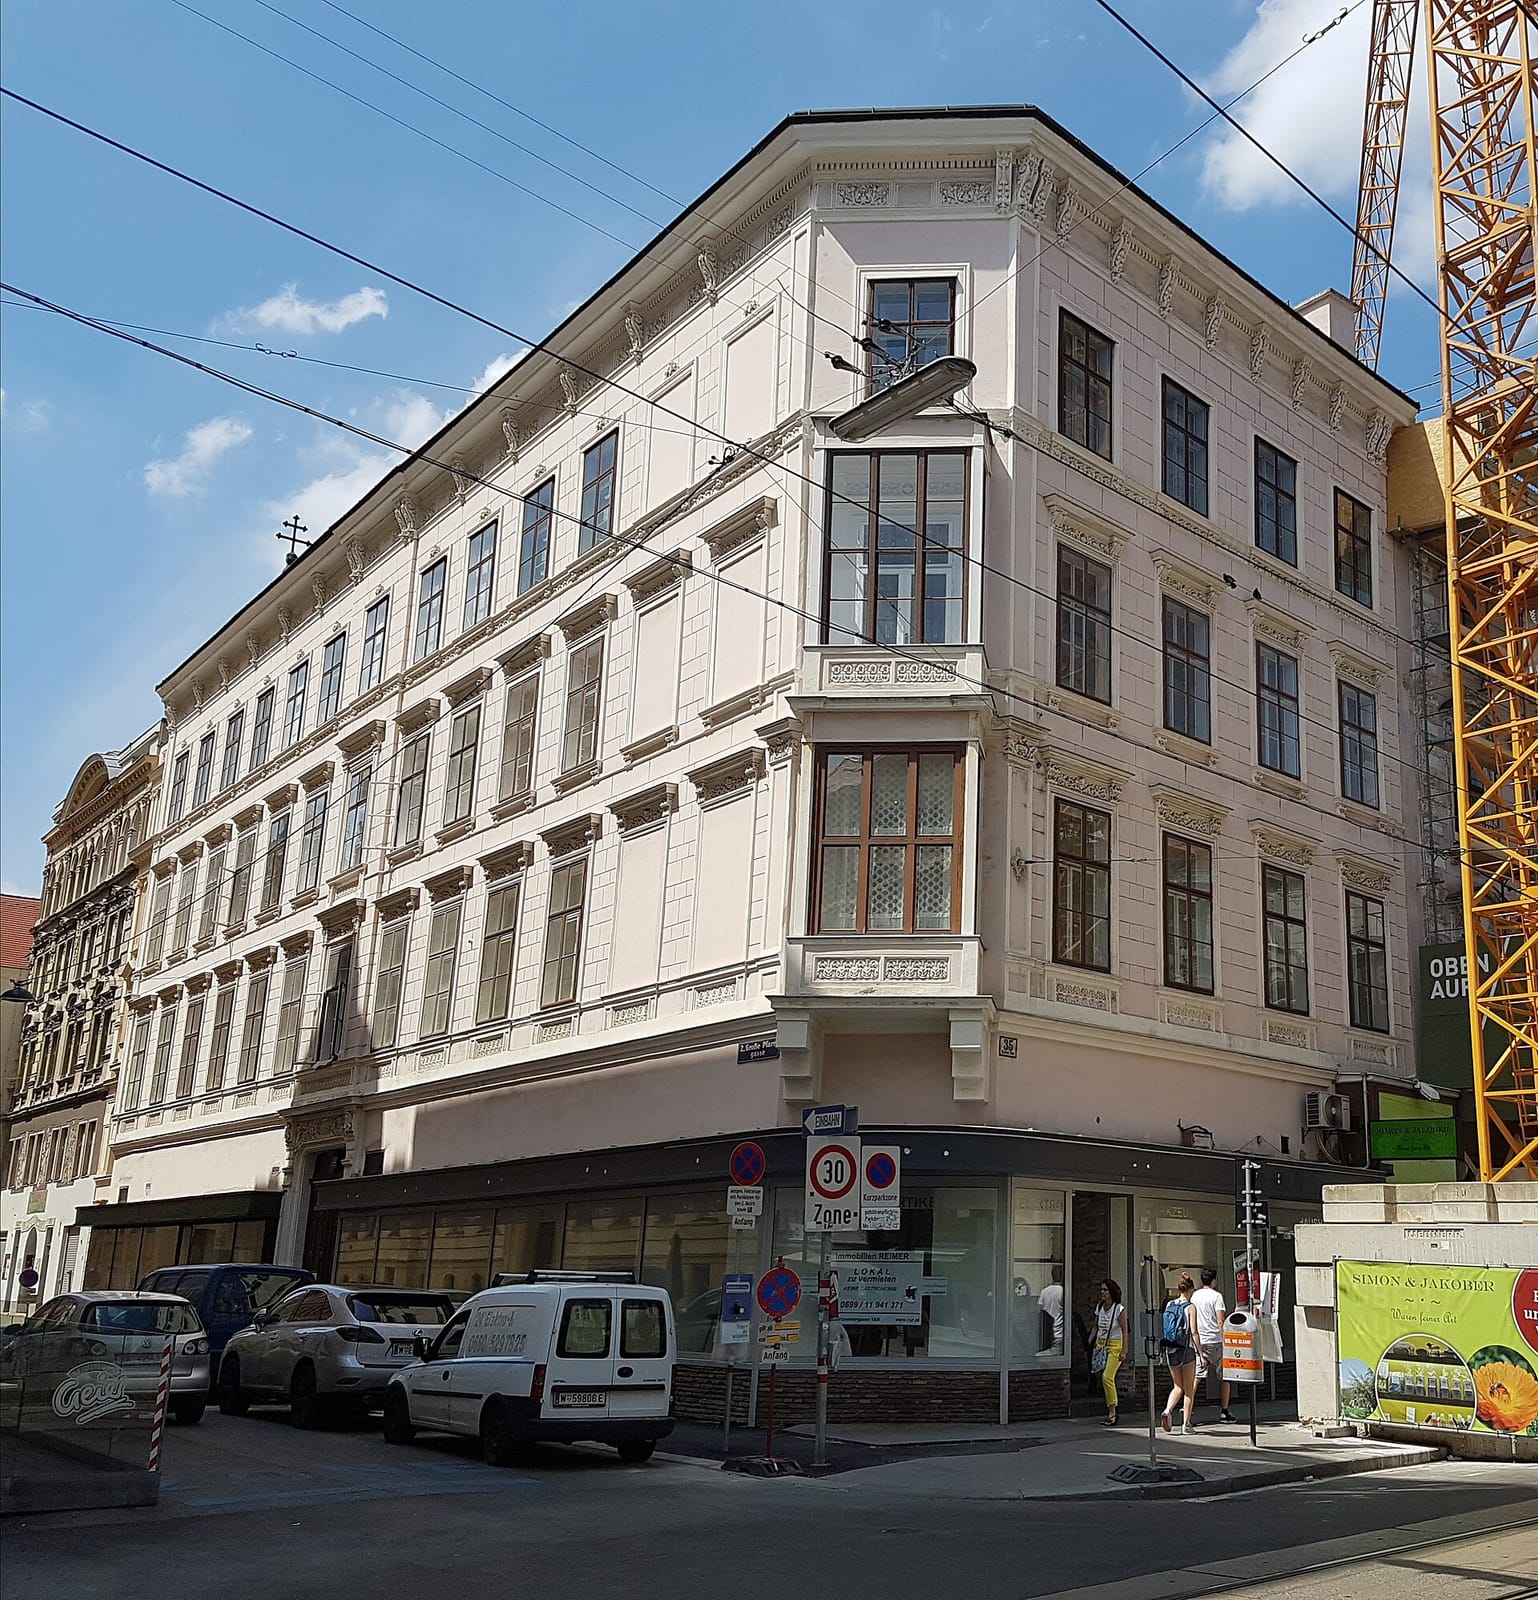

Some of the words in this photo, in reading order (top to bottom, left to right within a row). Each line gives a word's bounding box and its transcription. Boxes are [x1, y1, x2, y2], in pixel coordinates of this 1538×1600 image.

[1003, 1038, 1014, 1052] 35
[750, 1050, 766, 1059] gasse
[815, 1112, 841, 1128] EINBAHN
[823, 1159, 845, 1184] 30
[863, 1193, 898, 1203] Kurzparkzone
[813, 1204, 852, 1225] Zone
[734, 1217, 754, 1228] Anfang
[835, 1251, 877, 1260] Immobilien
[878, 1251, 910, 1260] REIMER
[858, 1275, 897, 1283] vermieten
[1352, 1273, 1401, 1287] SIMON
[1404, 1277, 1416, 1288] &
[1419, 1277, 1496, 1292] JAKOBER
[1390, 1307, 1417, 1322] Waren
[1418, 1311, 1441, 1326] feiner
[763, 1351, 789, 1361] Anfang
